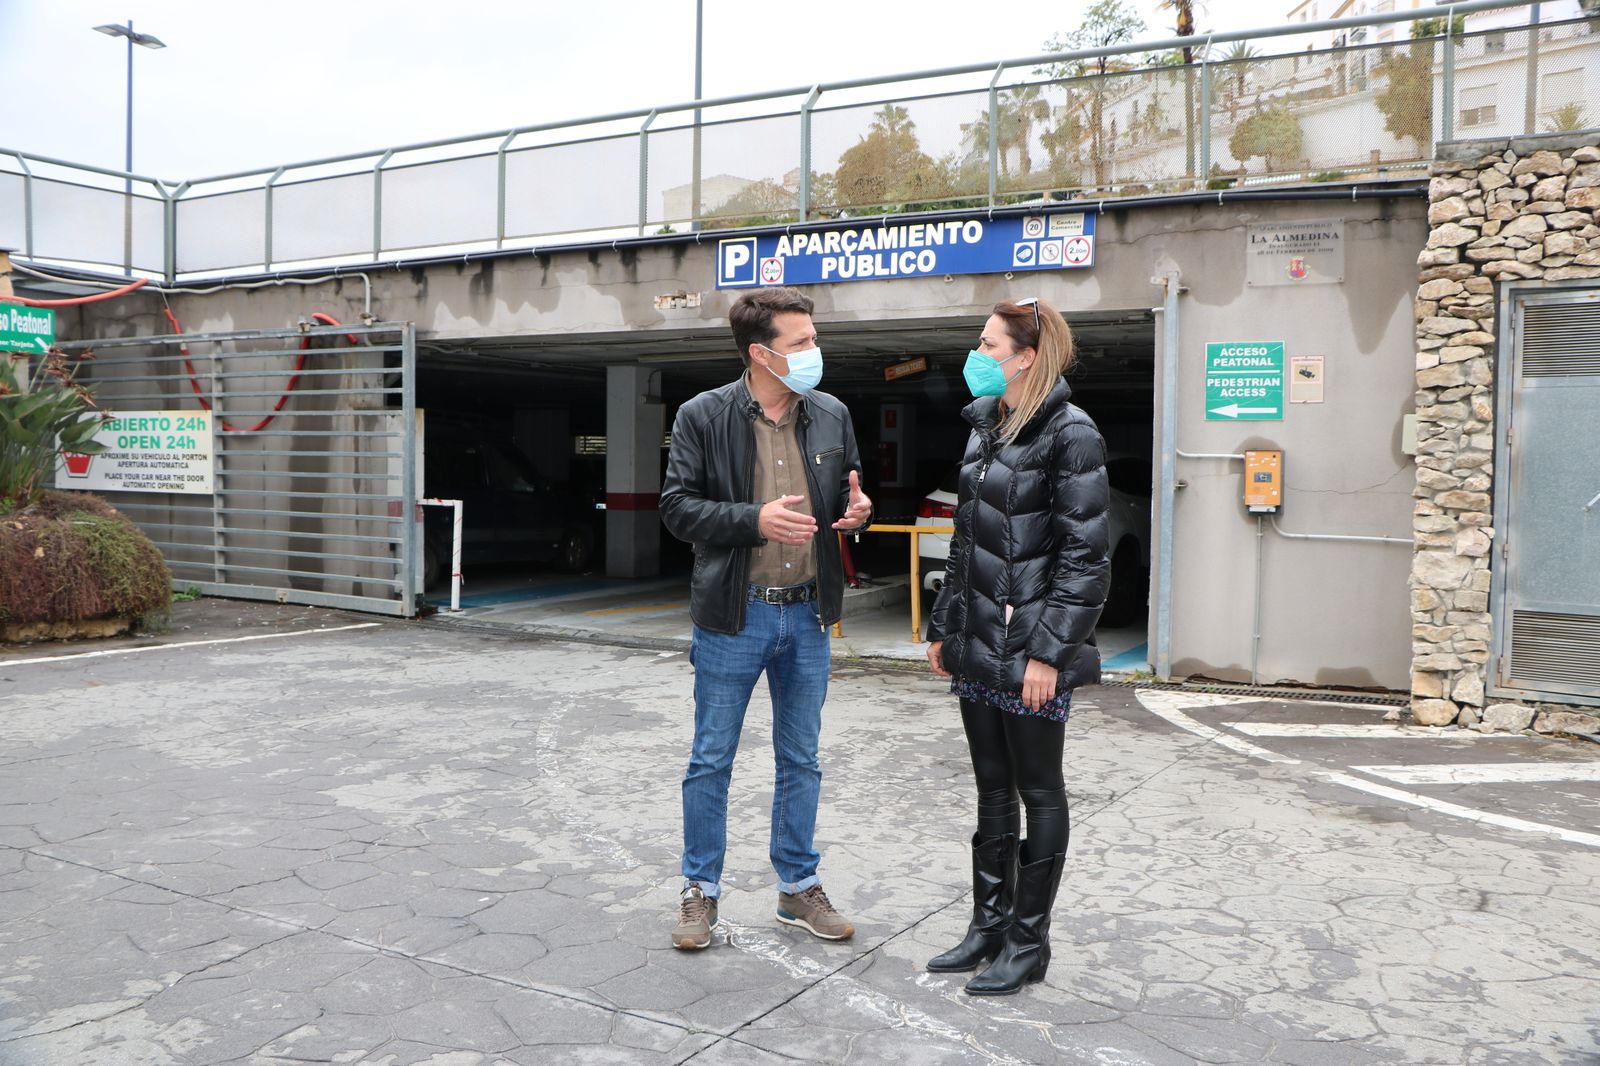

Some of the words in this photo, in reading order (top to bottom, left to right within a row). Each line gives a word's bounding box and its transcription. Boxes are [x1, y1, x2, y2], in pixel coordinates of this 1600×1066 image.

[1029, 223, 1039, 231] 20
[1051, 223, 1082, 231] Comercial
[725, 244, 750, 279] P
[11, 309, 52, 335] Peatonal
[1220, 347, 1267, 356] ACCESO
[1213, 357, 1275, 366] PEATONAL
[1207, 377, 1280, 387] PEDESTRIAN
[1220, 388, 1267, 397] ACCESS
[101, 417, 171, 431] ABIERTO
[176, 417, 206, 431] 24h
[117, 435, 161, 449] OPEN
[167, 436, 196, 449] 24h
[101, 452, 129, 460] APROXIME
[182, 453, 207, 461] PORTON
[150, 461, 189, 469] AUTOMATICA
[104, 472, 123, 480] PLACE
[173, 474, 185, 482] THE
[123, 481, 156, 489] AUTOMATIC
[157, 482, 185, 490] OPENING
